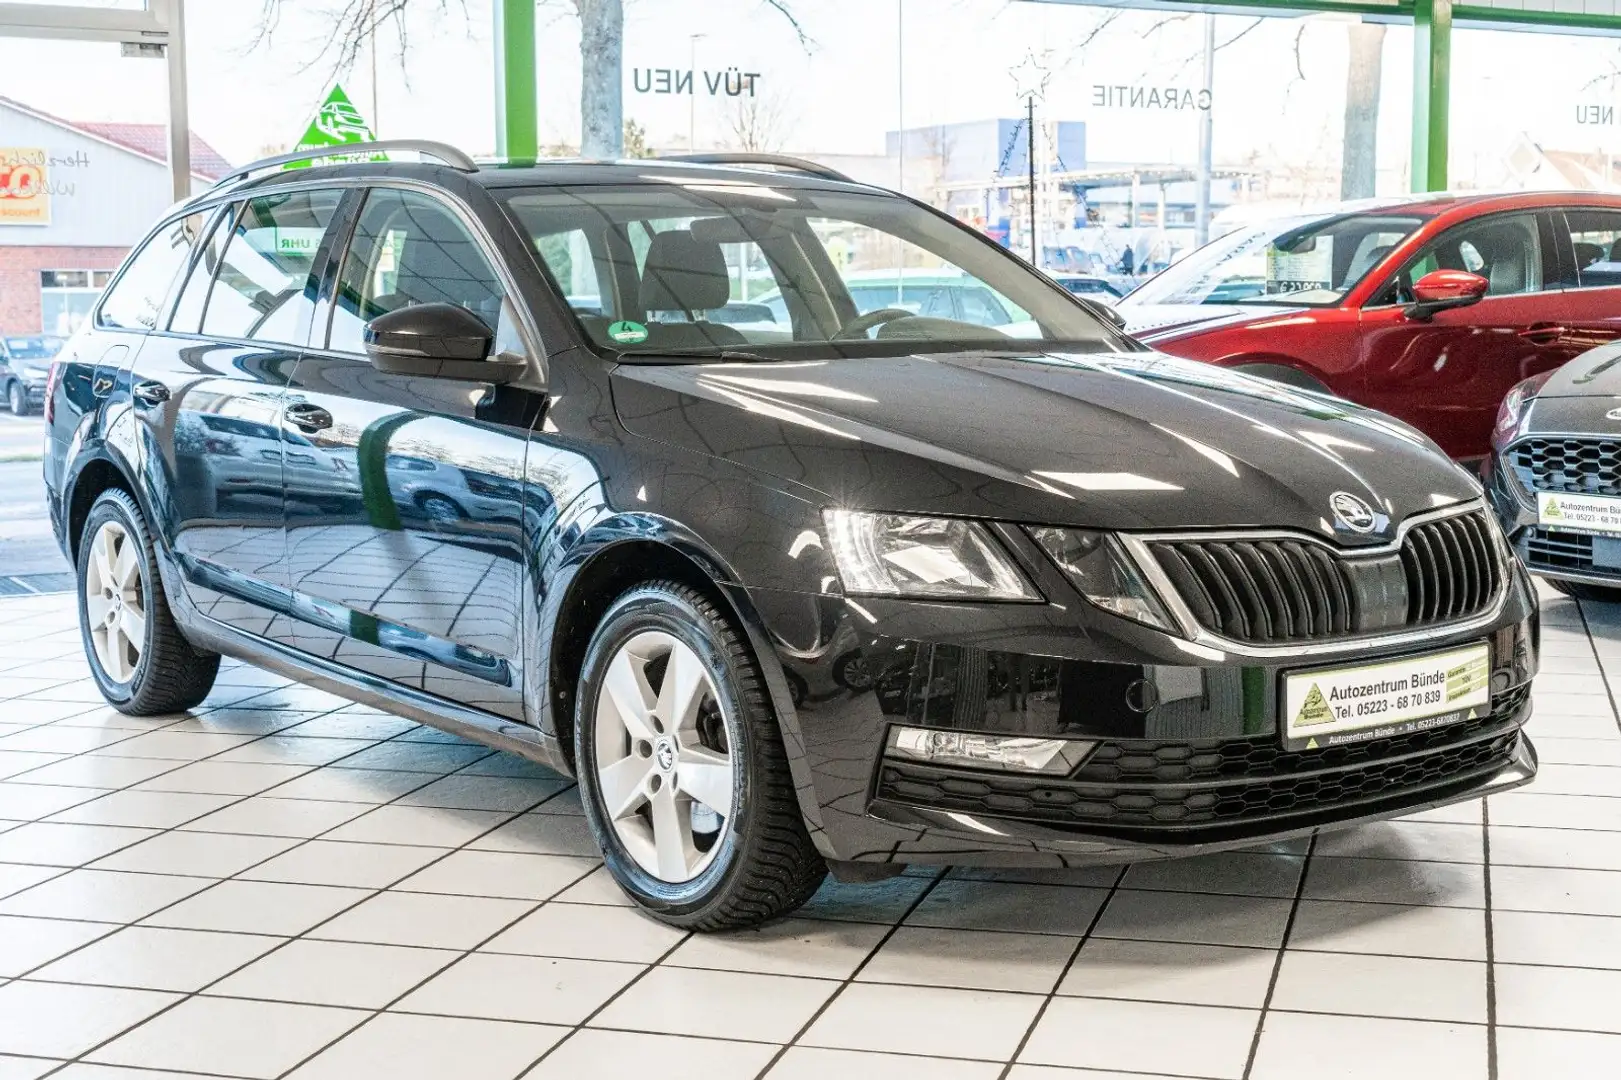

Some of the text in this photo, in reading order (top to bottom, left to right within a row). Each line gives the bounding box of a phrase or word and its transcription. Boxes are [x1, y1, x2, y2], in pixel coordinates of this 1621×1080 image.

[1560, 501, 1608, 513] Autozentrum
[1329, 670, 1445, 701] Autozentrum Bünde
[1335, 705, 1354, 719] Tel.
[1357, 700, 1388, 716] 05223
[1397, 696, 1408, 710] 68
[1411, 693, 1421, 707] 70
[1424, 690, 1440, 705] 839
[1329, 731, 1373, 744] Autozentrum
[1375, 726, 1395, 738] Bünde
[1406, 722, 1416, 731] Tel.
